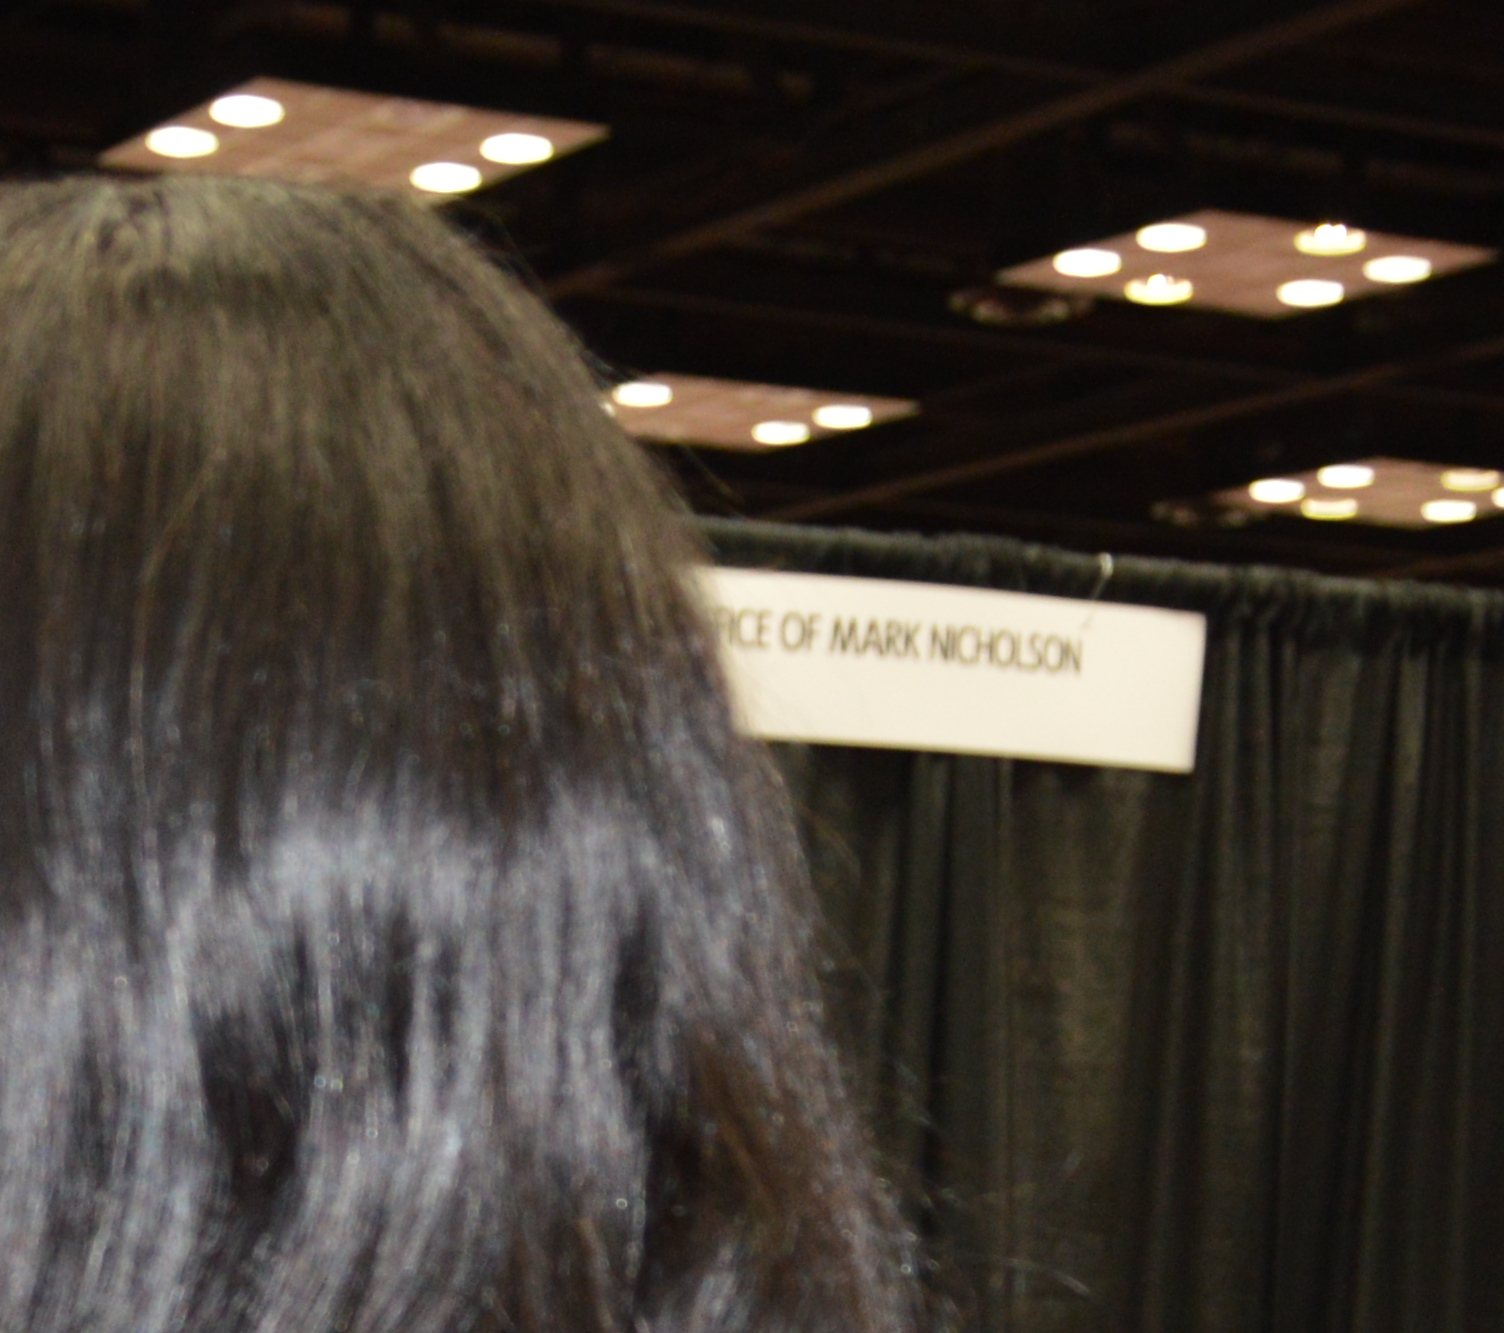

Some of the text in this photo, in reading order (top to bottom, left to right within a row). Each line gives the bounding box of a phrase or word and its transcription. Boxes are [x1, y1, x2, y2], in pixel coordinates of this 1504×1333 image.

[780, 610, 822, 650] OF
[830, 616, 921, 661] MARK
[930, 624, 1083, 674] NICHOLSON
